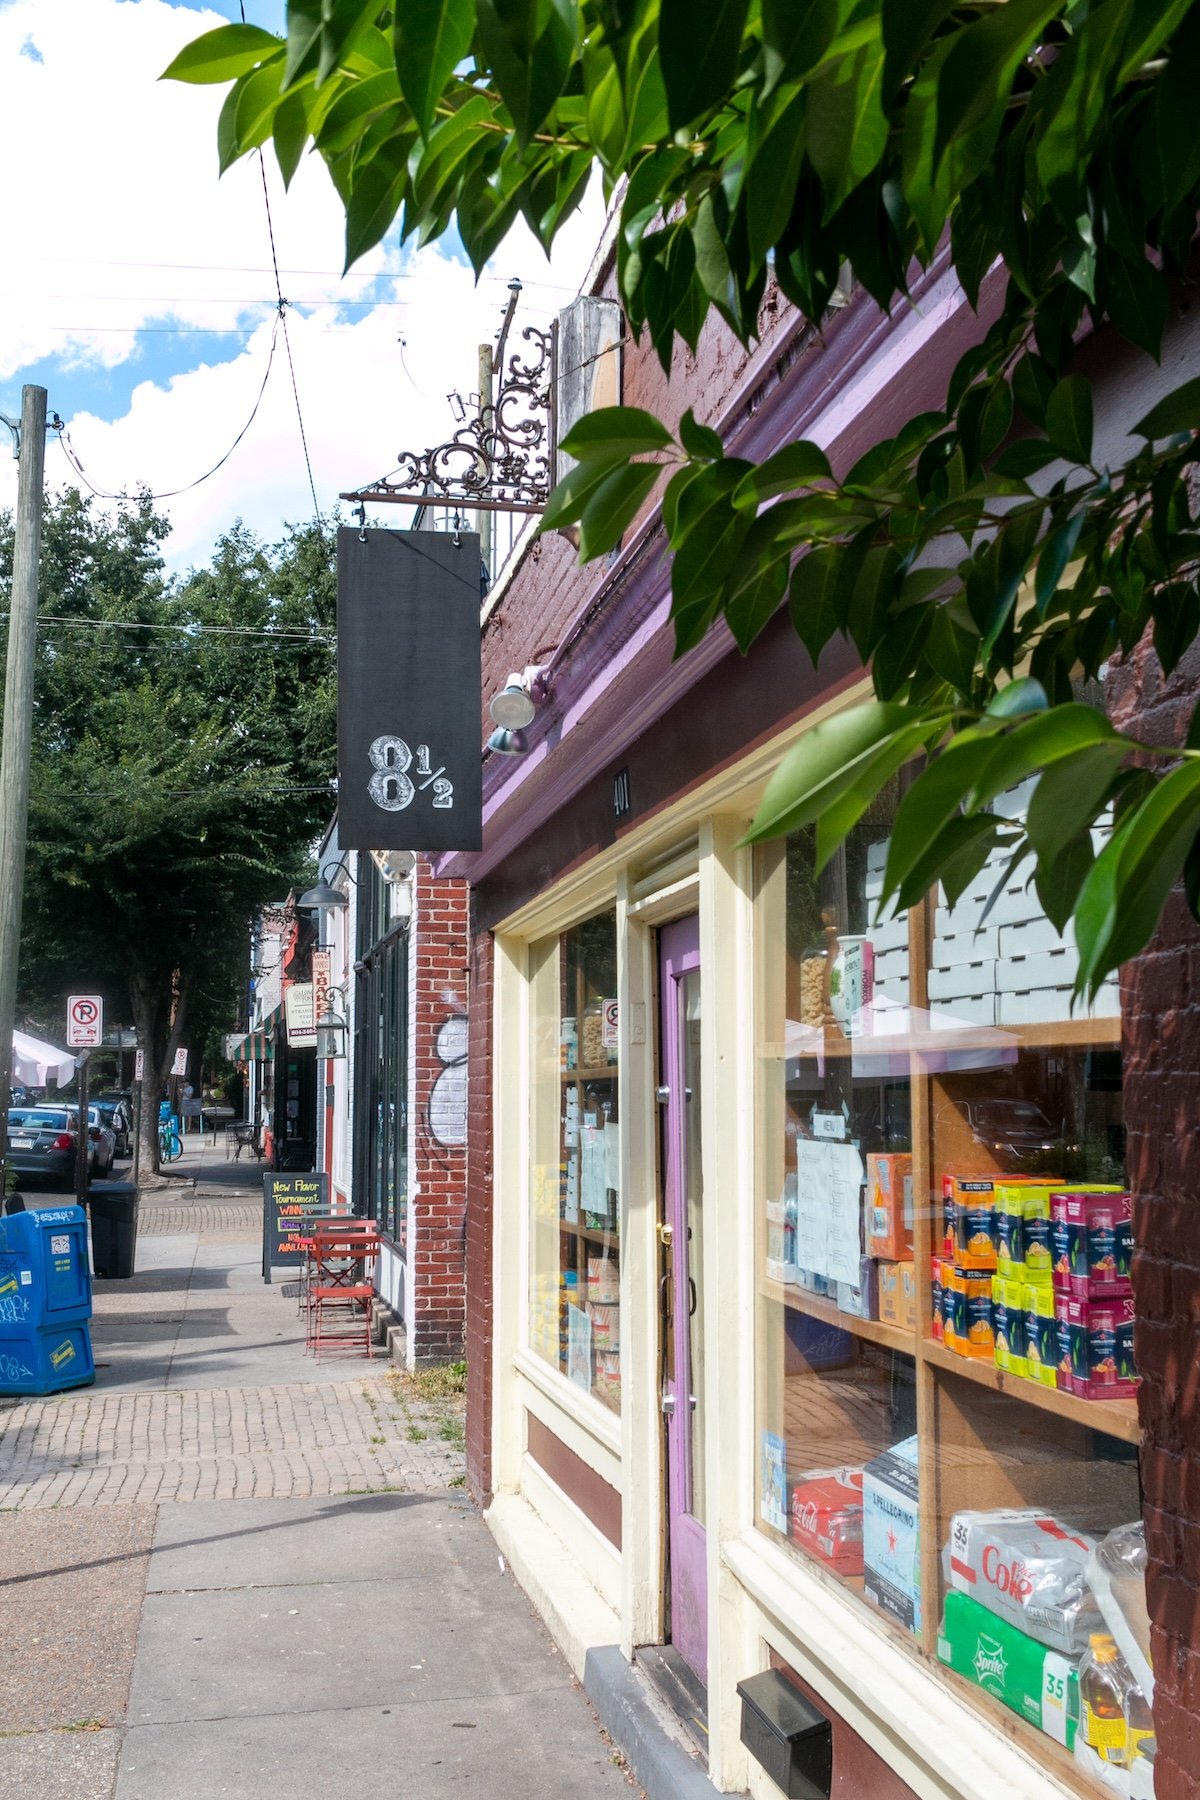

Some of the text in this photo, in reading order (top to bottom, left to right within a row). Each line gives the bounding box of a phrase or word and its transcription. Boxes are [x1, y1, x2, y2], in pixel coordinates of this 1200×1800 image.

[613, 772, 630, 816] 401
[272, 1194, 320, 1204] Tournament
[273, 1180, 320, 1193] New Flavor
[954, 1521, 968, 1546] 35
[981, 1545, 1033, 1605] Coke
[976, 1650, 1004, 1675] Sprite
[1046, 1672, 1064, 1699] 35
